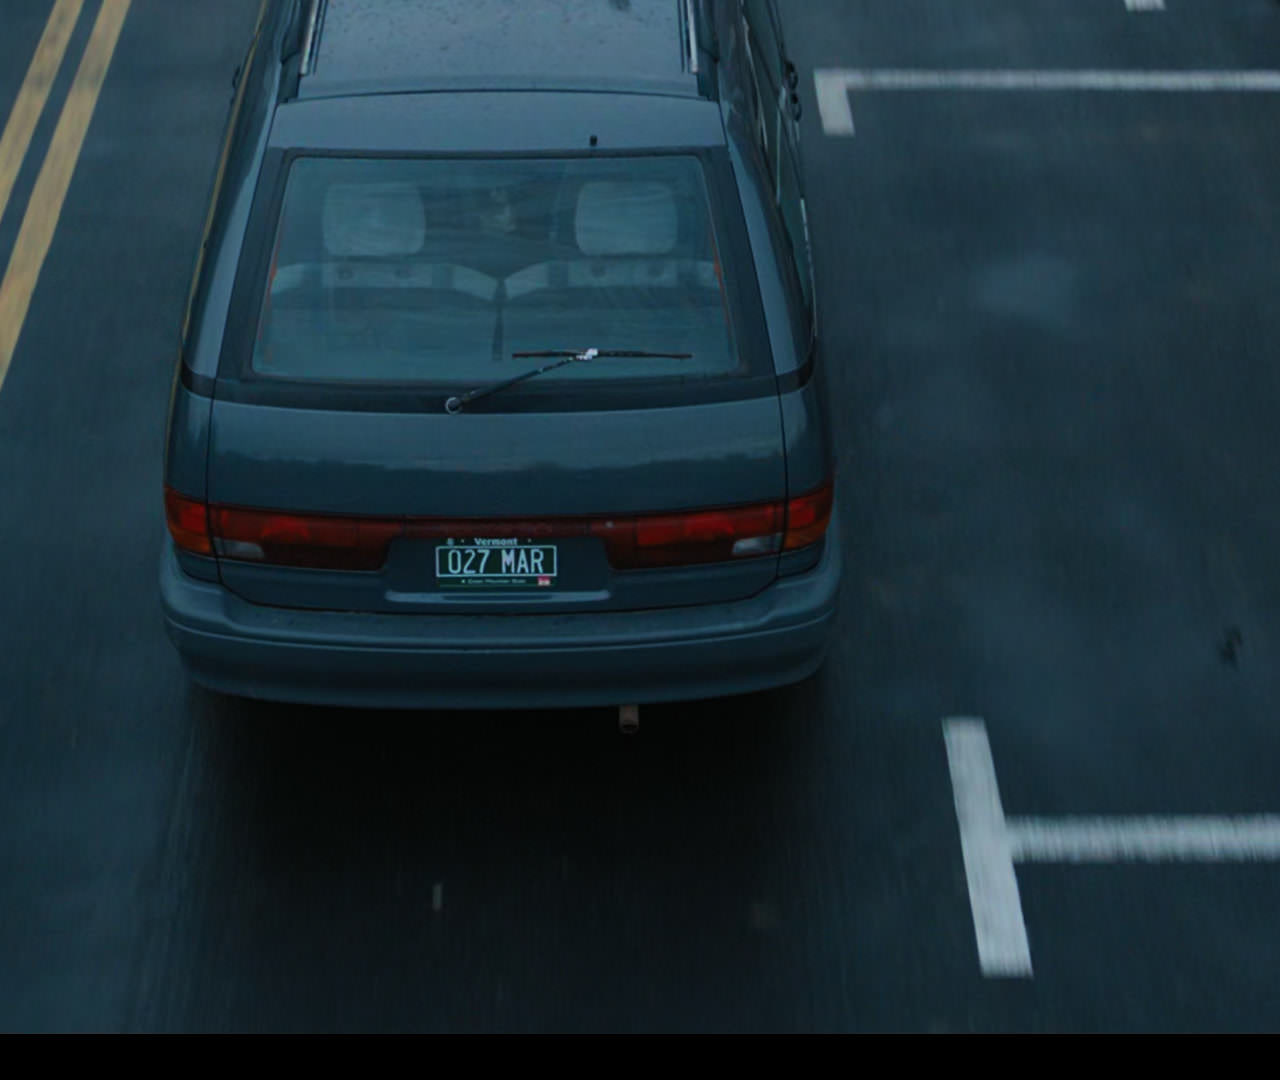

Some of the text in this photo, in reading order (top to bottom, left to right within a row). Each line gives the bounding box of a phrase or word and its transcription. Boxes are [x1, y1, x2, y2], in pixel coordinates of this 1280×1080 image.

[474, 537, 517, 546] Vermont
[448, 549, 544, 574] 027 MAR
